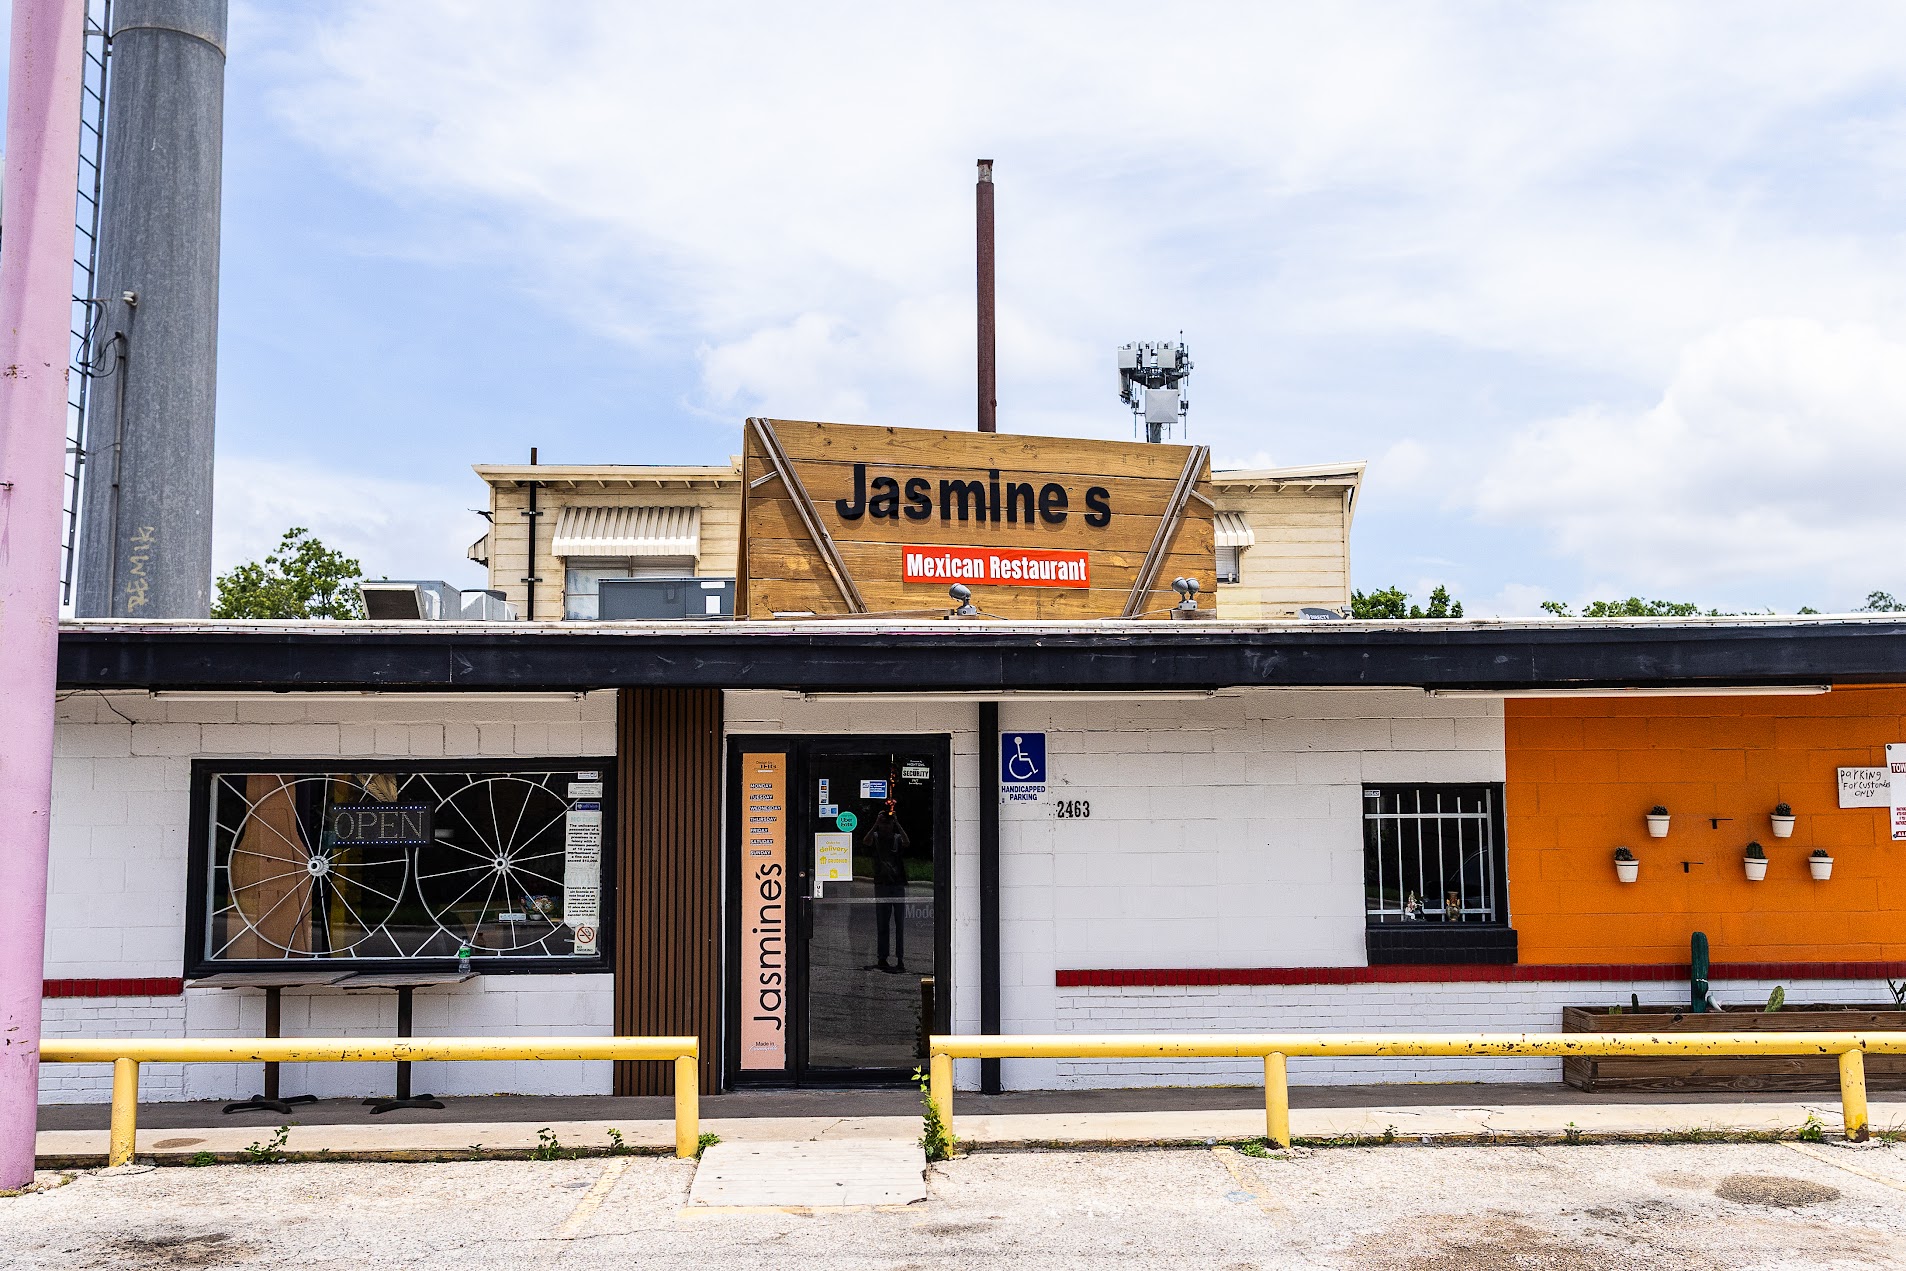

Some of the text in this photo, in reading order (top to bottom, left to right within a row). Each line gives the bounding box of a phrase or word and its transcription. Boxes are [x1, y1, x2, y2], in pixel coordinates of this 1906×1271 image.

[906, 553, 1086, 581] Mexican Restaurant
[1001, 785, 1046, 793] HANDICAPPED
[1854, 789, 1875, 797] ONLY
[1009, 793, 1038, 801] PARKING
[1057, 800, 1090, 818] 2463
[334, 811, 424, 839] OPEN
[819, 845, 848, 854] delivery
